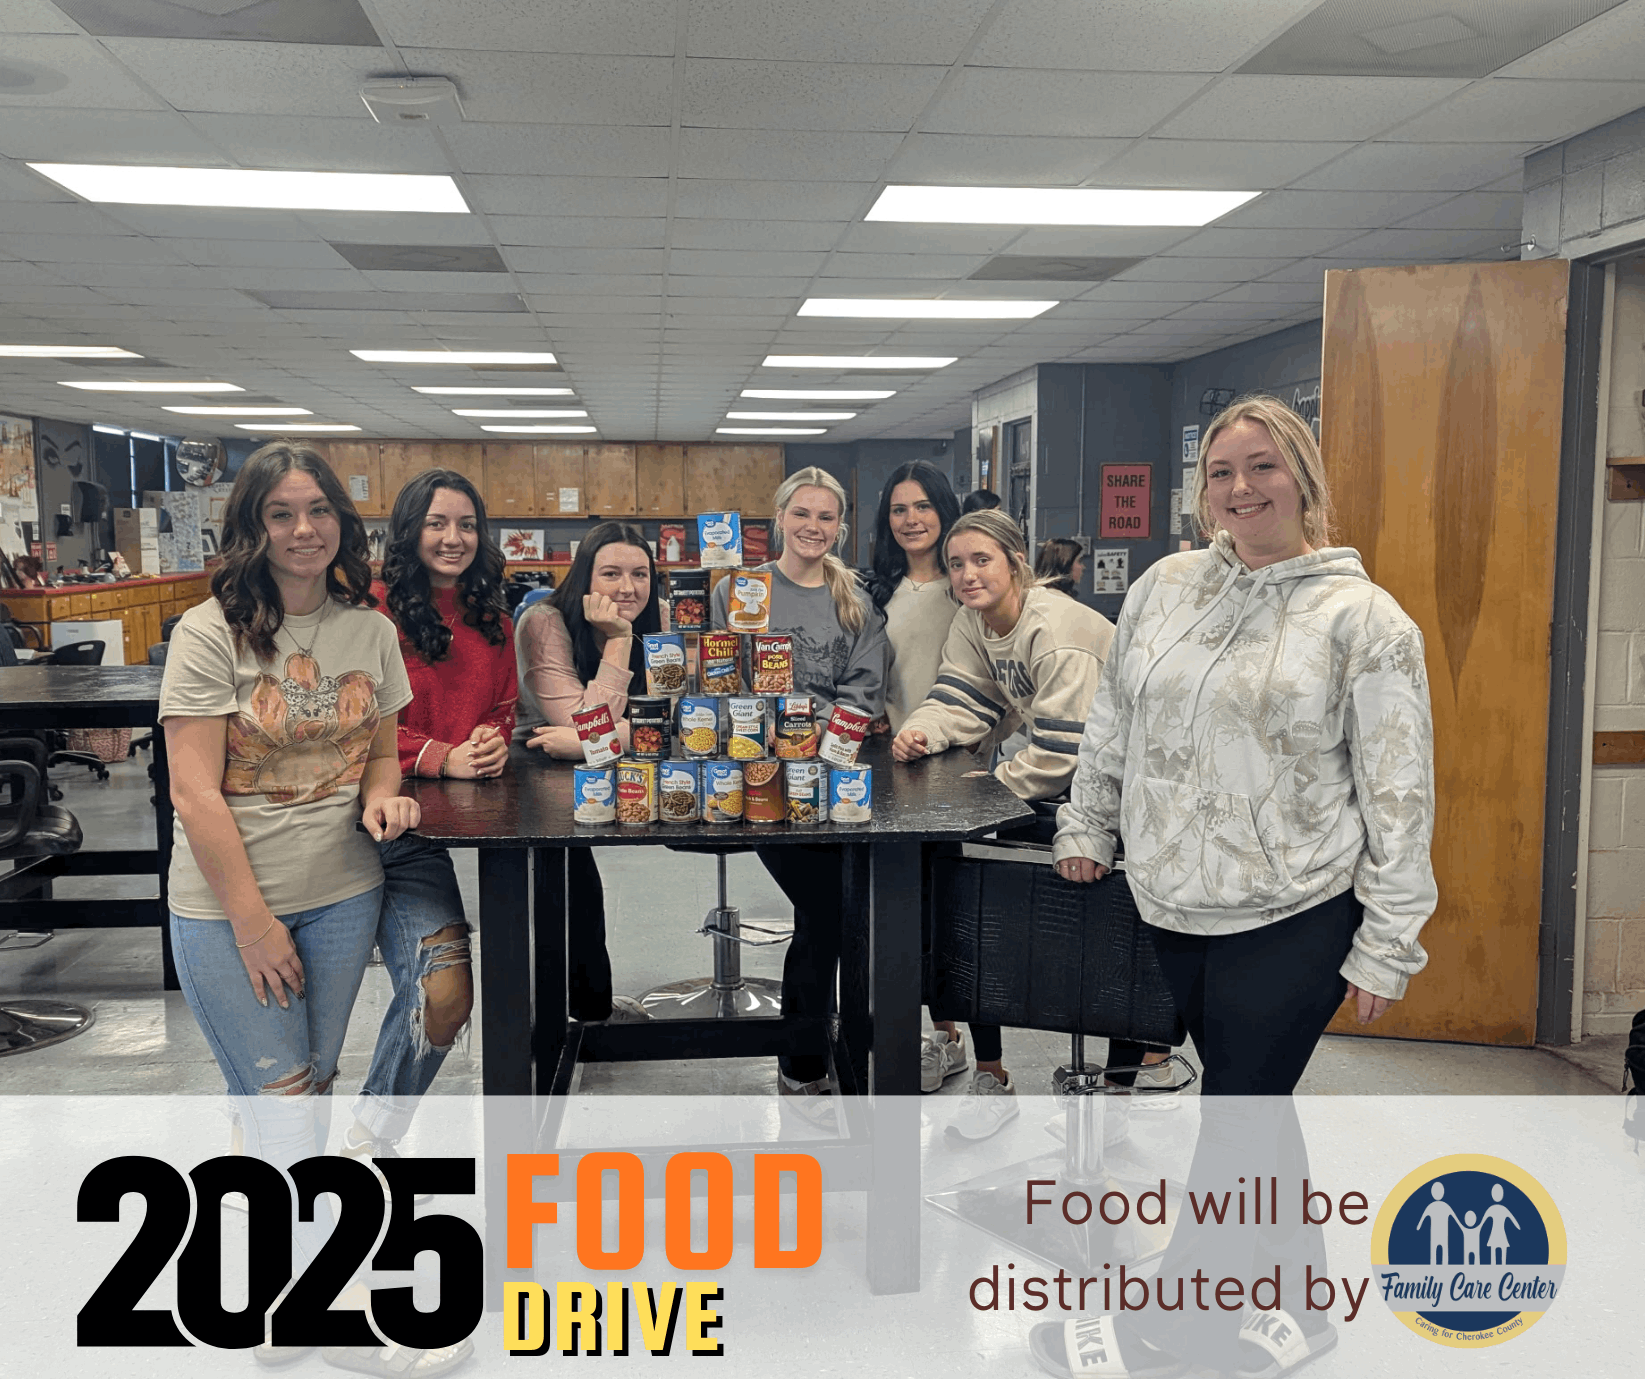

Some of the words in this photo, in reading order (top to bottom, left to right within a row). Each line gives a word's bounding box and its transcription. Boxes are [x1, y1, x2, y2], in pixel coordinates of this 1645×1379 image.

[1107, 474, 1146, 487] SHARE
[1114, 495, 1136, 508] THE
[1109, 516, 1141, 529] ROAD
[738, 590, 764, 598] Pumpkin
[703, 638, 738, 648] Hormel
[708, 647, 734, 657] Chili
[762, 660, 788, 669] BEANS
[589, 746, 608, 755] Tomato
[618, 771, 643, 783] UCK'S
